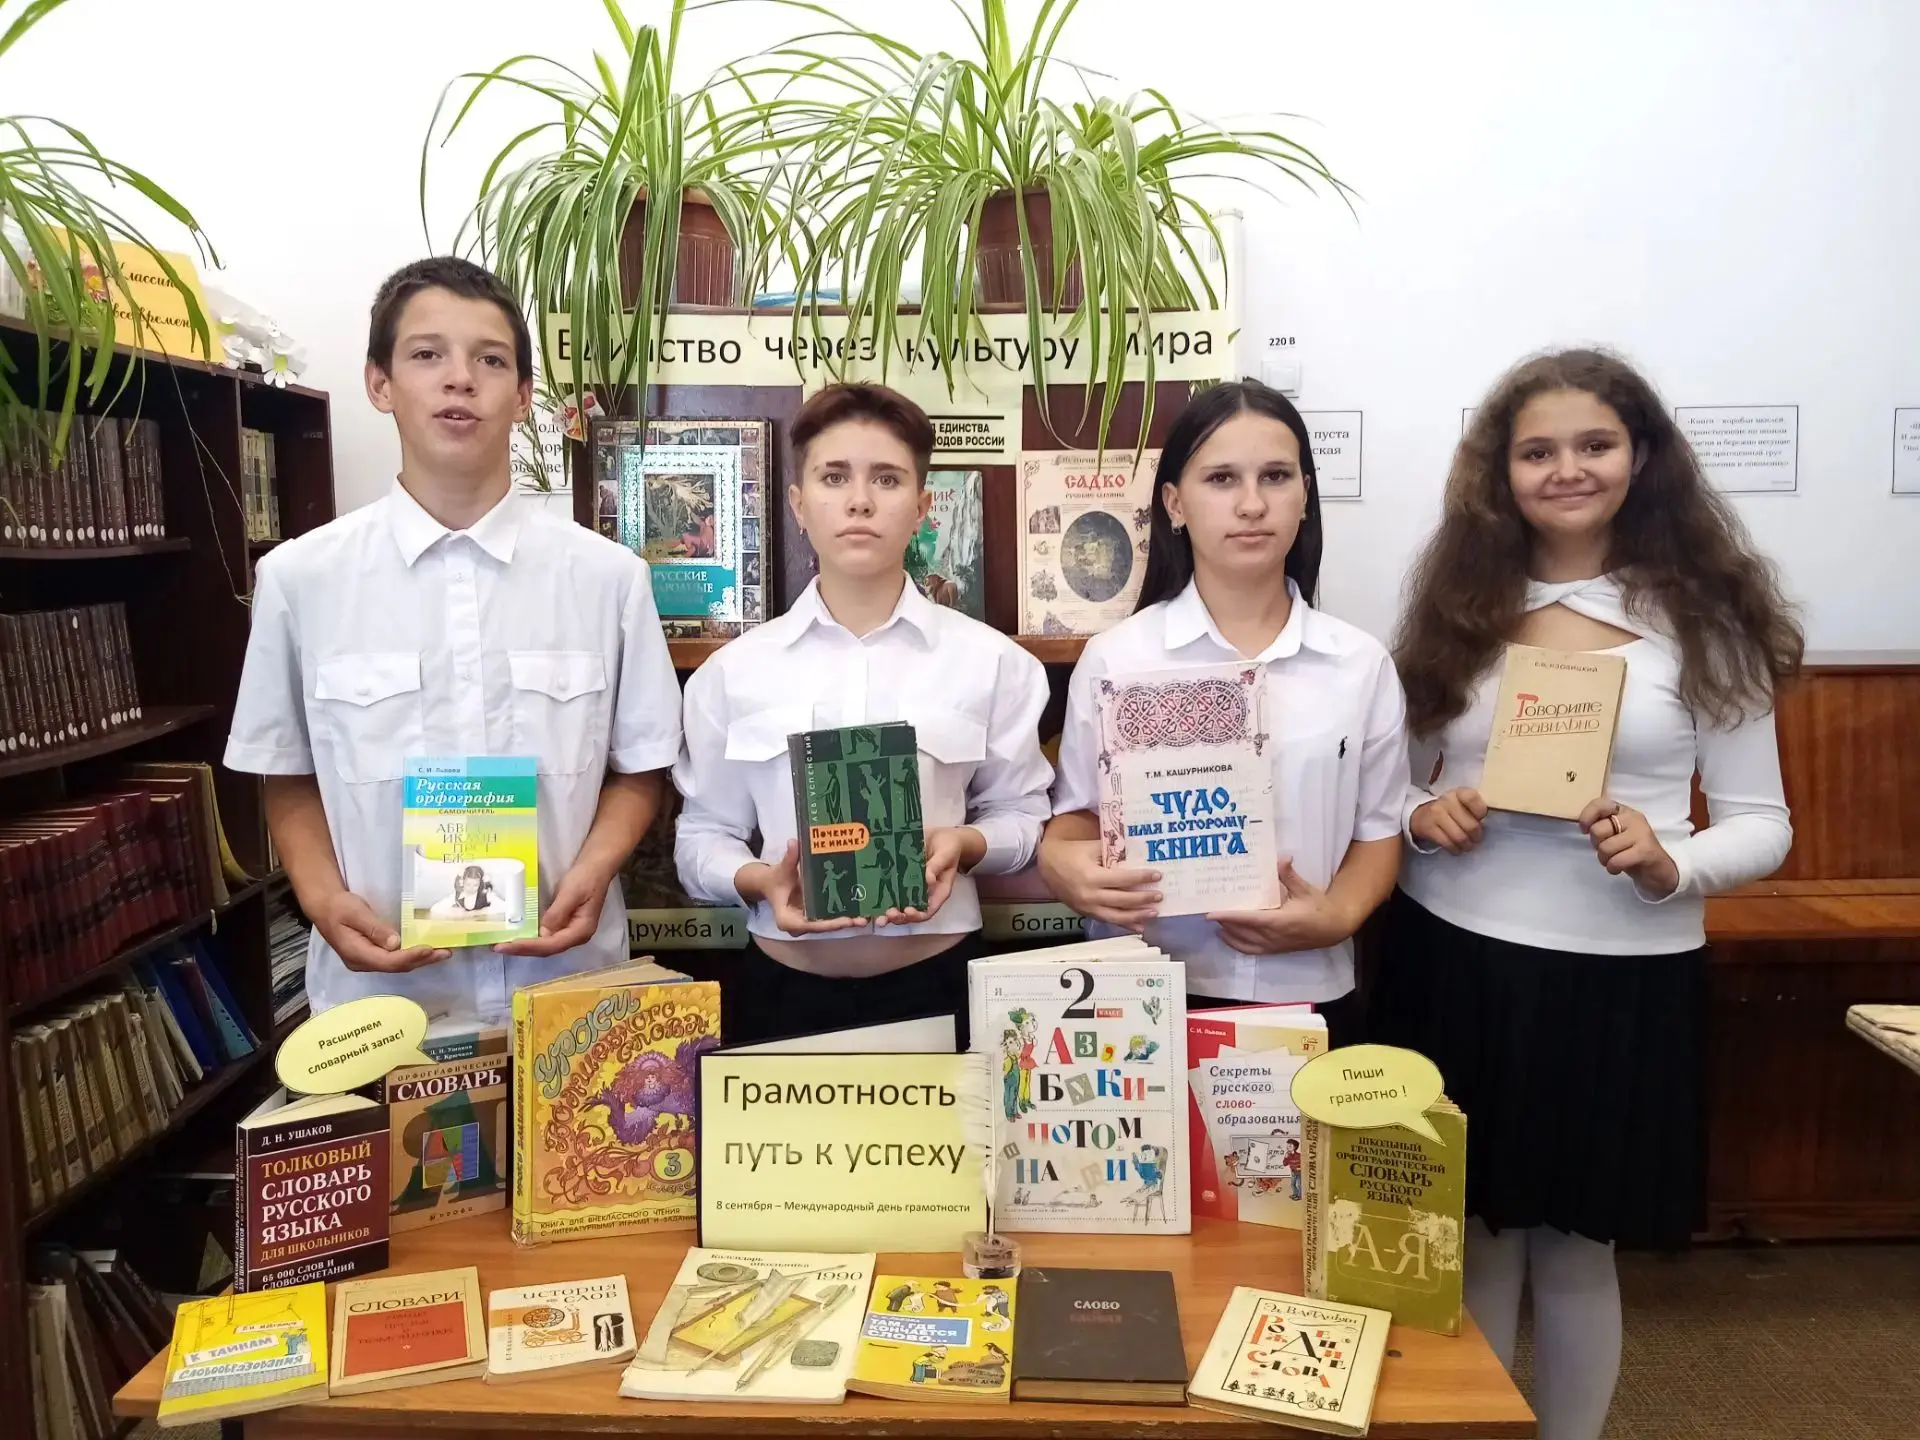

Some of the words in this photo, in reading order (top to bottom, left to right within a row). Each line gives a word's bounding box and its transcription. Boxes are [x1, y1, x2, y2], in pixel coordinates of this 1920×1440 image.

[139, 307, 191, 329] времен
[765, 336, 877, 368] через
[1269, 337, 1287, 347] 220
[939, 423, 990, 434] ЕДИНСТВА
[1314, 430, 1349, 441] пуста
[965, 436, 1005, 446] РОССИИ
[1065, 474, 1126, 490] САДКО
[1516, 693, 1602, 718] Говорите
[1509, 719, 1600, 736] правильно
[804, 736, 816, 797] УСПЕНСКИЙ
[1167, 764, 1233, 777] КАШУРНИКОВА
[416, 778, 481, 793] Русская
[416, 792, 515, 806] орфография
[1150, 787, 1236, 819] ЧУДО,
[1128, 823, 1162, 837] ИМЯ
[1168, 815, 1247, 833] КОТОРОМУ
[813, 840, 826, 848] НЕ
[1146, 831, 1248, 862] КНИГА
[721, 923, 734, 938] и
[1012, 912, 1086, 932] богатс
[1060, 968, 1096, 1019] 2
[318, 1019, 383, 1050] Расширяем
[308, 1042, 370, 1075] словарный
[372, 1029, 405, 1050] запас!
[397, 1058, 502, 1082] ОРФОГРАФИЧЕСКИЙ
[1210, 1065, 1272, 1078] Секреты
[1342, 1067, 1385, 1081] Пиши
[397, 1069, 502, 1101] СЛОВАРЬ
[723, 1075, 956, 1111] Грамотность
[1212, 1082, 1272, 1095] русского
[1216, 1099, 1256, 1109] слово-
[1329, 1090, 1398, 1106] грамотно
[1217, 1114, 1301, 1127] образования
[262, 1136, 271, 1147] Д.
[275, 1133, 286, 1143] Н.
[288, 1124, 332, 1141] УШАКОВ
[1028, 1117, 1142, 1150] ПОТОМ
[1359, 1136, 1422, 1152] ШКОЛЬНЫЙ
[261, 1140, 372, 1179] ТОЛКОВЫЙ
[664, 1152, 681, 1177] 3
[725, 1142, 803, 1172] путь
[816, 1143, 834, 1165] к
[845, 1143, 965, 1174] успеху
[1308, 1141, 1318, 1190] СЛОВАРЬ
[1336, 1152, 1446, 1174] ОРФОГРАФИЧЕСКИЙ
[261, 1164, 372, 1201] СЛОВАРЬ
[1350, 1163, 1433, 1187] СЛОВАРЬ
[1360, 1180, 1422, 1196] РУССКОГО
[1367, 1191, 1413, 1206] ЯЗЫКА
[261, 1185, 372, 1223] РУССКОГО
[716, 1200, 723, 1210] 8
[725, 1200, 773, 1213] сентября
[784, 1201, 874, 1214] Международный
[877, 1202, 902, 1214] день
[905, 1203, 971, 1215] грамотности
[261, 1212, 343, 1245] ЯЗЫКА
[540, 1220, 565, 1230] КНИГА
[569, 1217, 584, 1226] ДЛЯ
[588, 1210, 649, 1223] ВНЕКЛАССНОГО
[652, 1208, 680, 1216] ЧТЕНИЯ
[260, 1247, 285, 1262] ДЛЯ
[288, 1227, 370, 1255] ШКОЛЬНИКОВ
[1344, 1224, 1431, 1281] А-Я
[262, 1262, 355, 1291] СЛОВОСОЧЕТАНИЙ
[277, 1268, 295, 1278] 000
[297, 1261, 325, 1275] СЛОВ
[327, 1258, 334, 1268] И
[816, 1271, 863, 1281] 1990
[564, 1291, 617, 1303] СЛОВ
[1074, 1300, 1120, 1310] СЛОВО
[869, 1324, 958, 1337] КОНЧАЕТСЯ
[908, 1322, 936, 1331] ГДЕ
[190, 1354, 200, 1363] К
